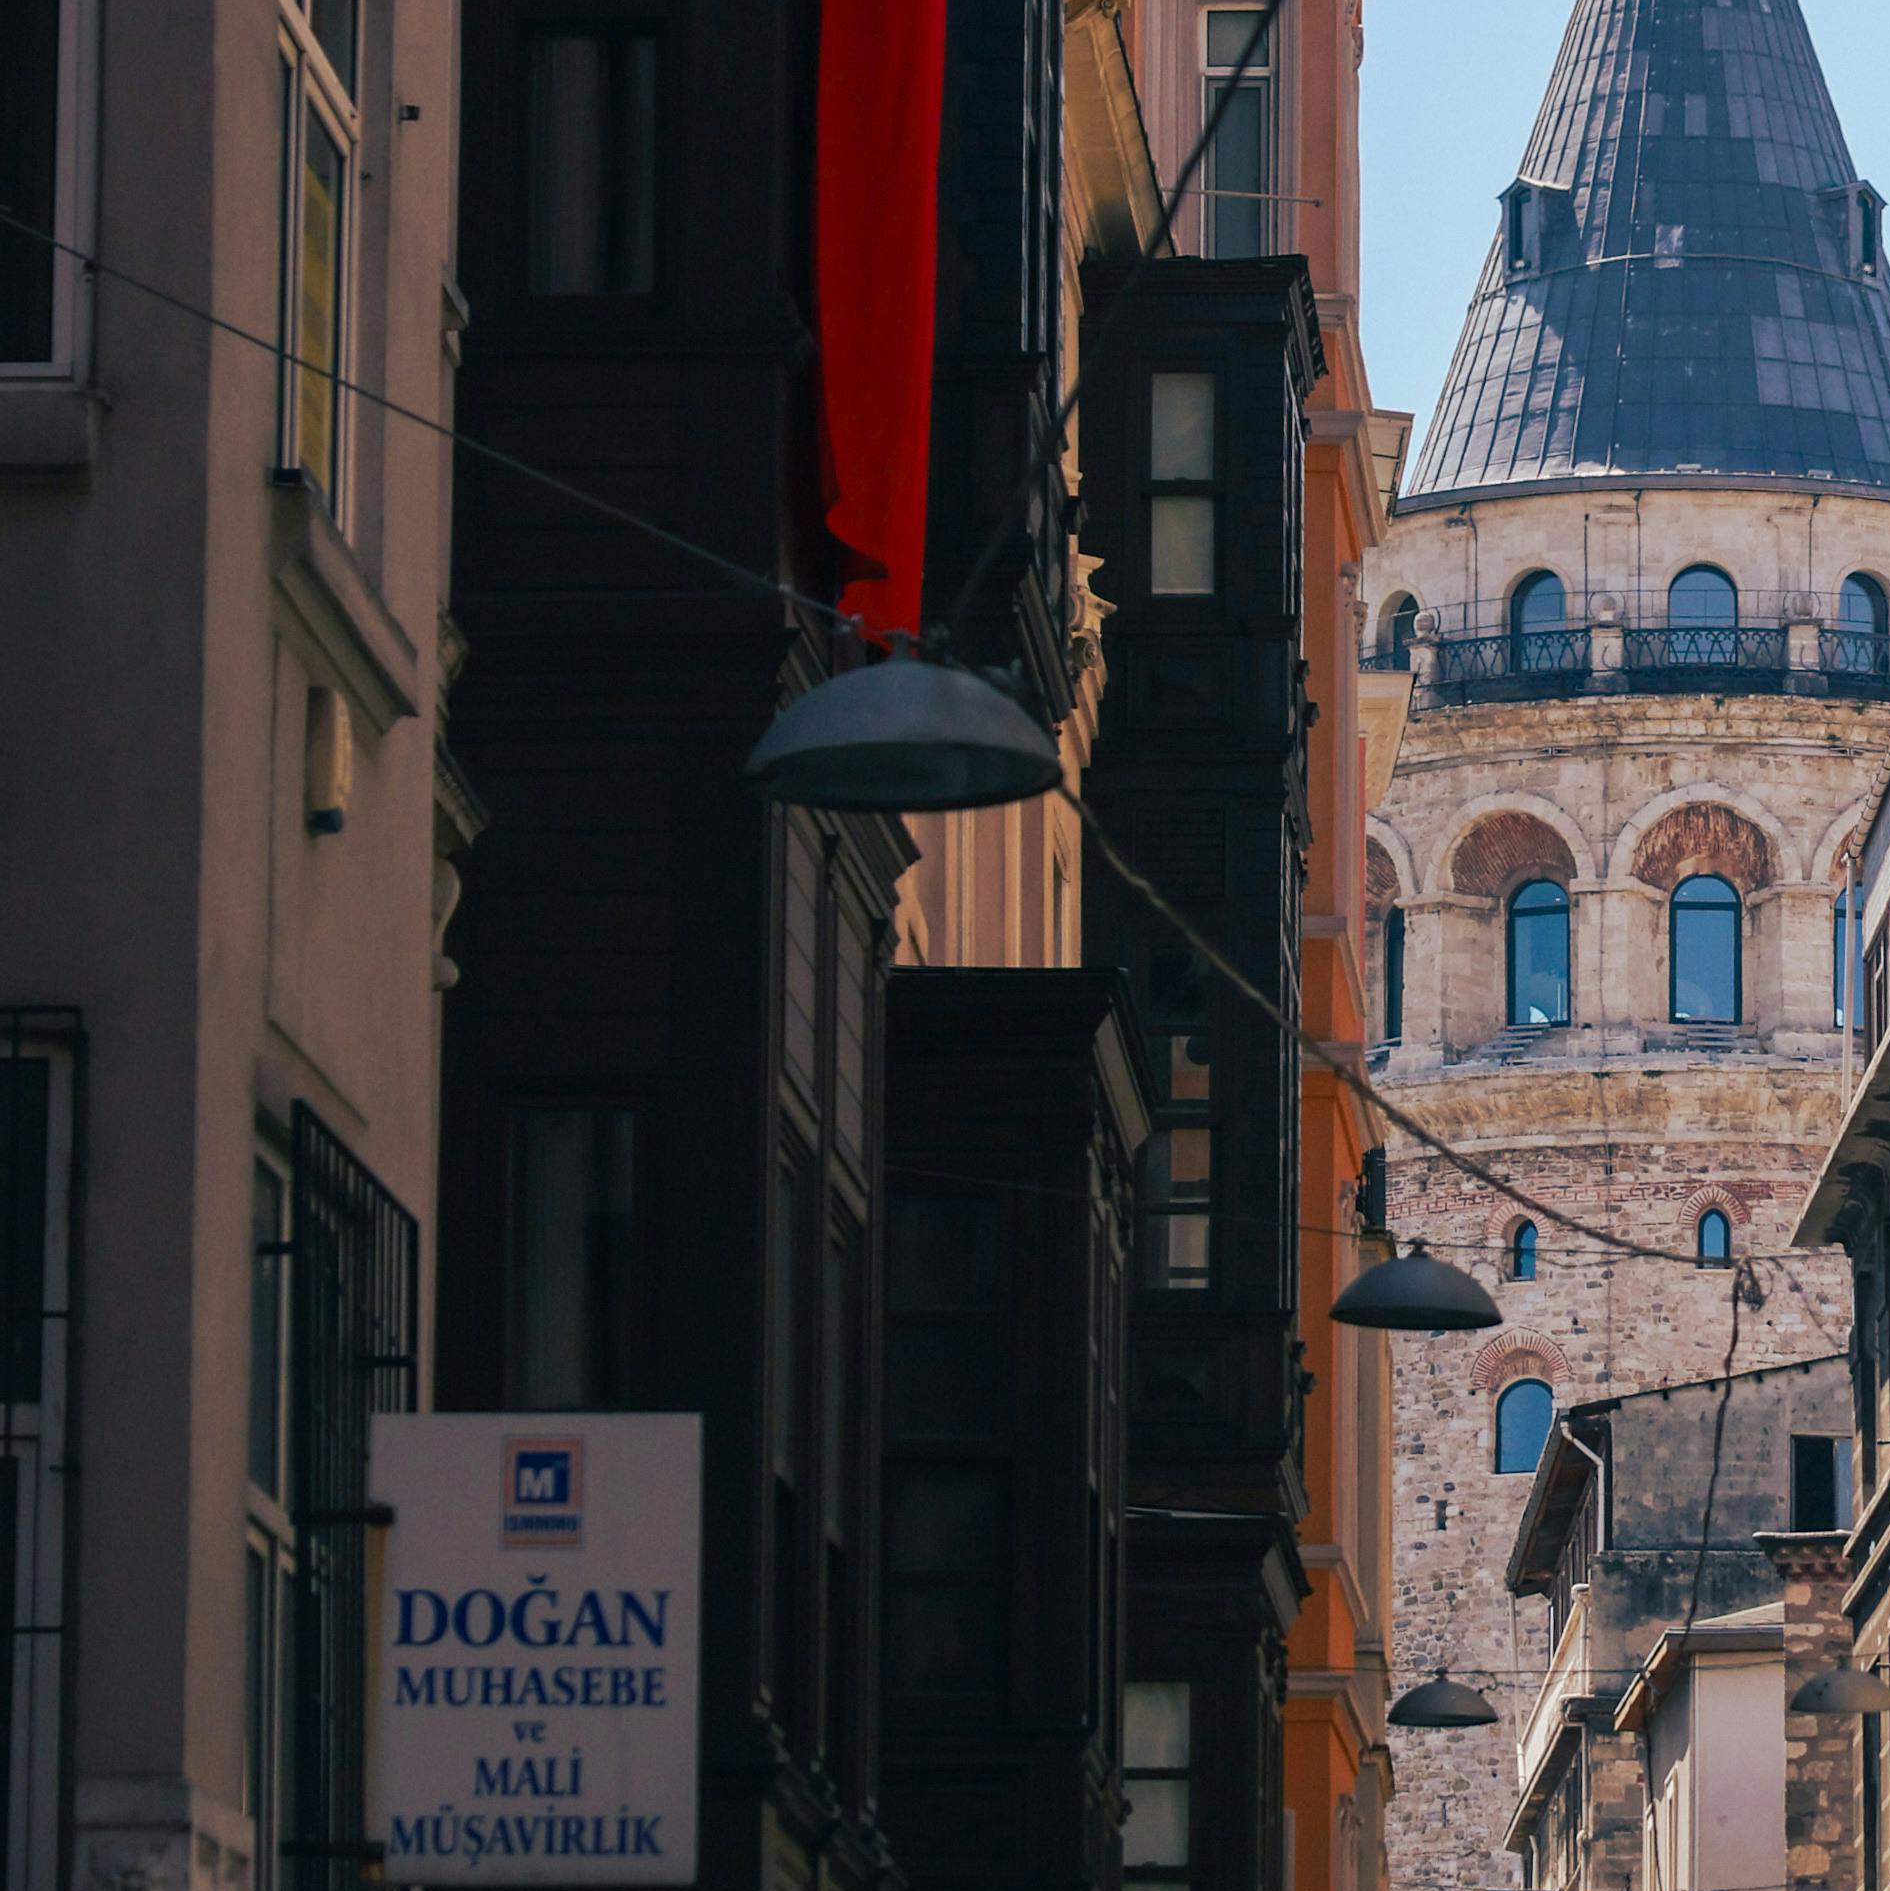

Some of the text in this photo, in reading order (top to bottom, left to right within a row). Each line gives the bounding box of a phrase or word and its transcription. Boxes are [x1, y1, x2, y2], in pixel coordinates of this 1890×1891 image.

[393, 1573, 672, 1649] DOĞAN
[394, 1665, 666, 1707] MUHASEBE
[513, 1719, 546, 1744] ve
[473, 1746, 584, 1798] MALİ
[388, 1802, 664, 1868] MÜŞAVİRLİK
